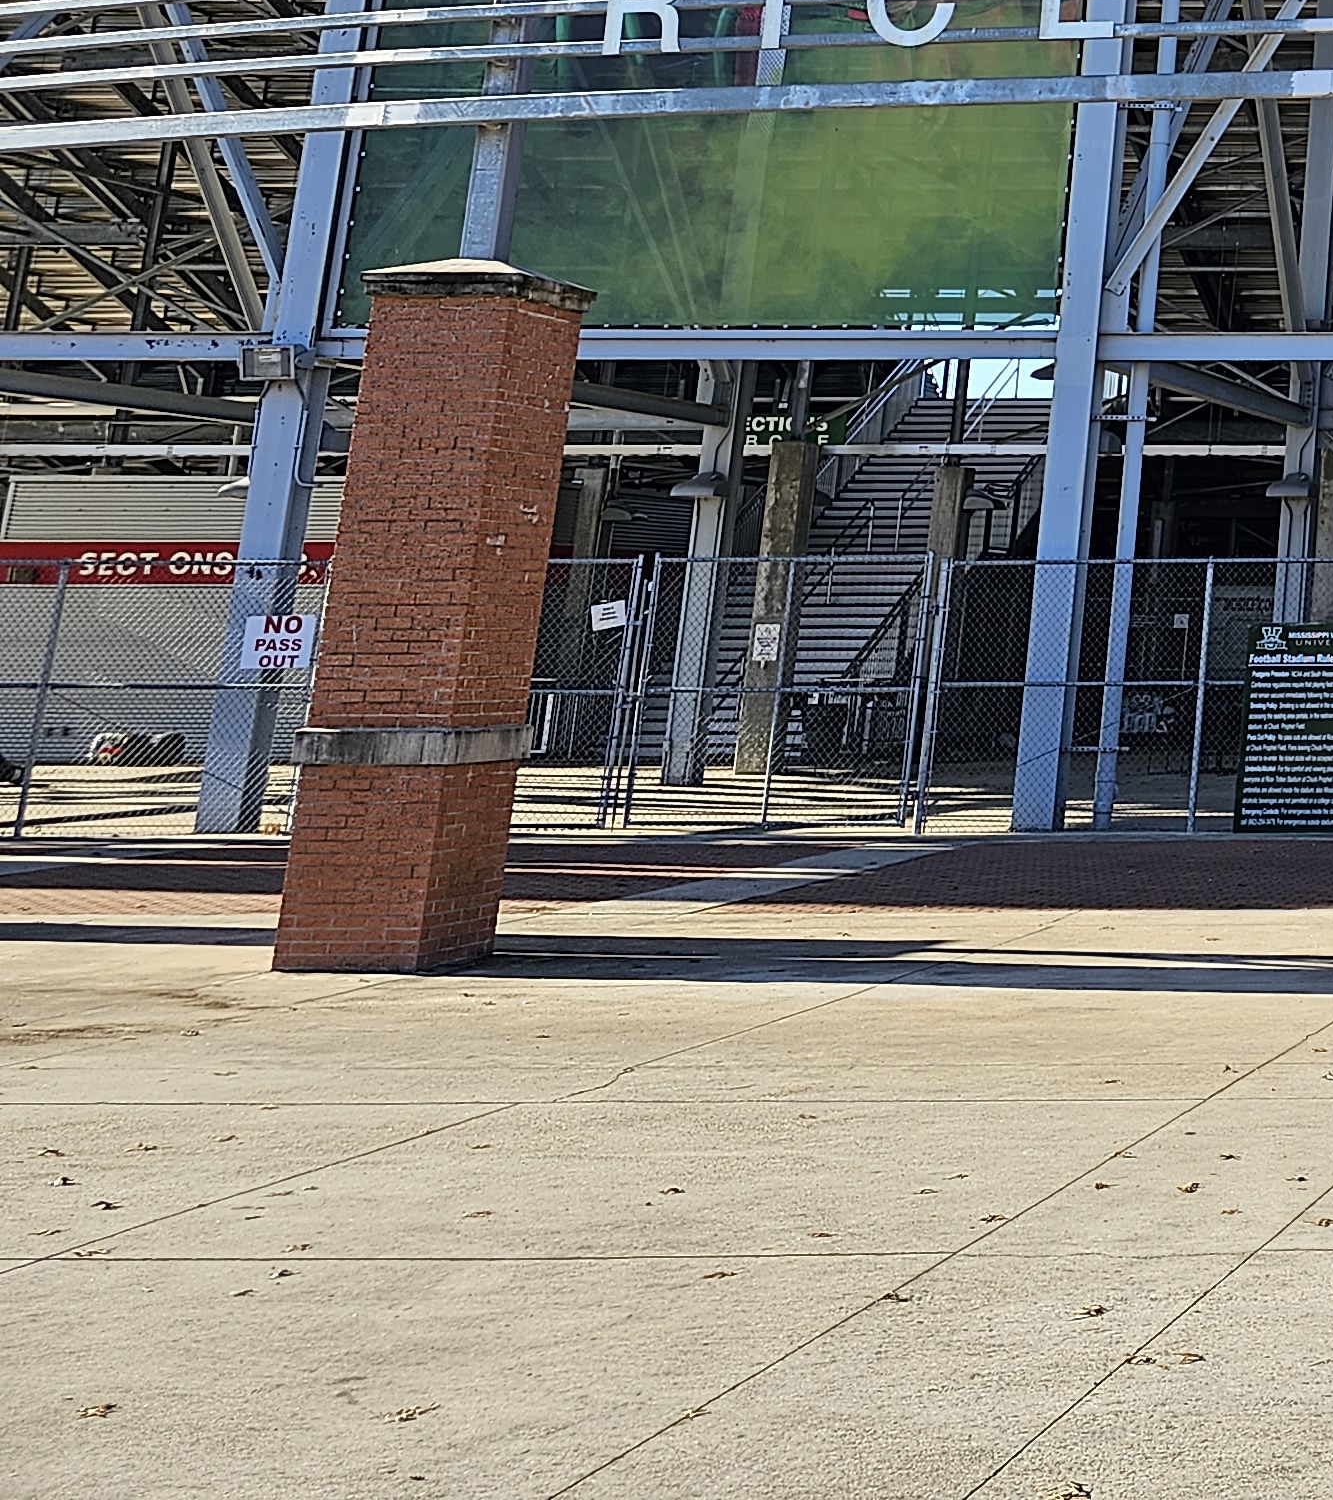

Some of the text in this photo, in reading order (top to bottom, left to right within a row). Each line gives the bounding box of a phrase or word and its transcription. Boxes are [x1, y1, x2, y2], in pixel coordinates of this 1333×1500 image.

[263, 615, 303, 634] NO
[254, 638, 303, 652] PASS
[258, 654, 300, 669] OUT
[1248, 653, 1282, 664] Football
[1282, 653, 1316, 664] Stadium
